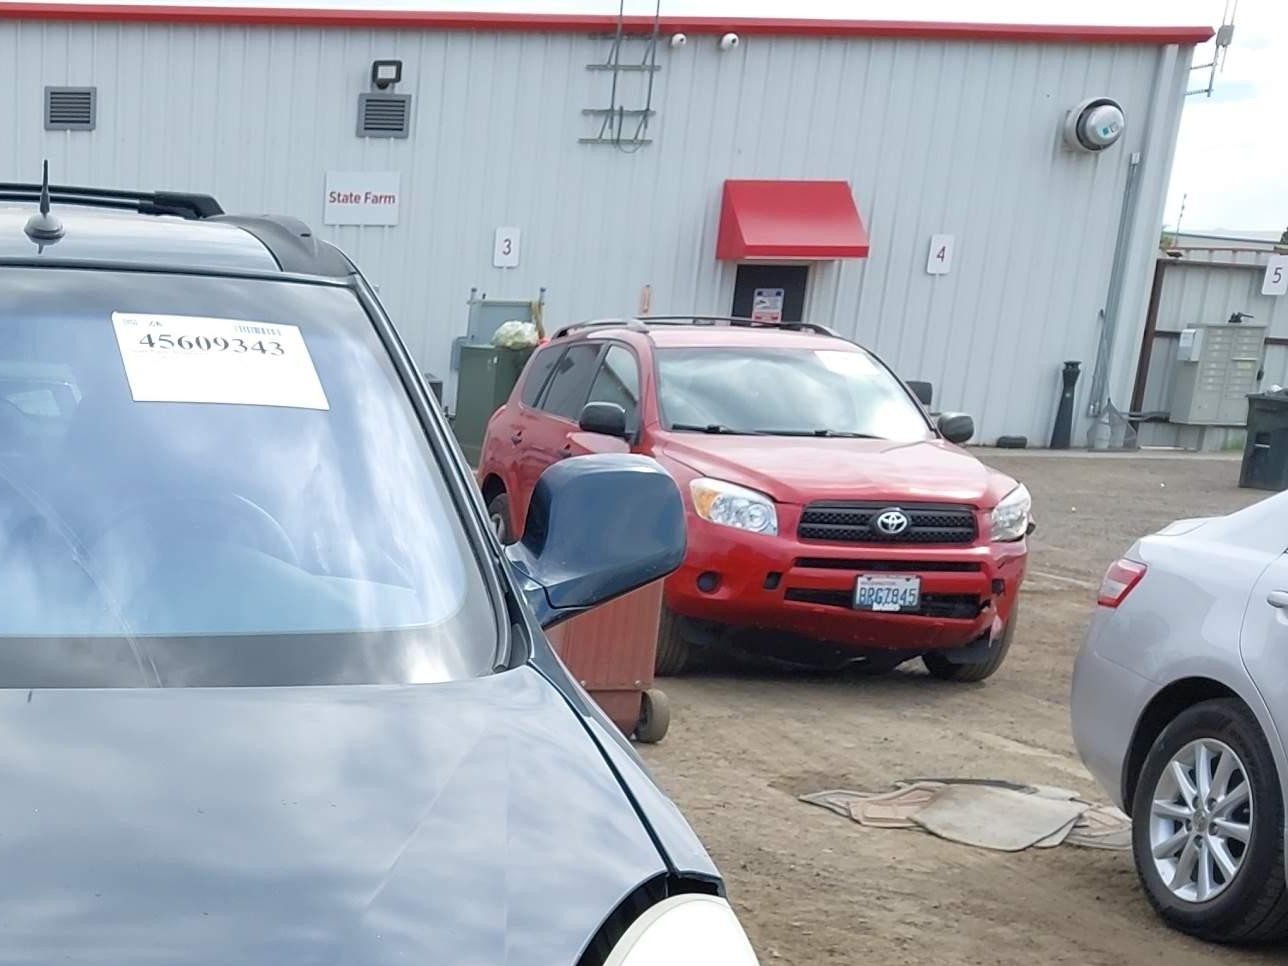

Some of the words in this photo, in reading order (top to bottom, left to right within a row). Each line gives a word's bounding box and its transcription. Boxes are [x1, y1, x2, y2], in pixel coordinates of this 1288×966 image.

[328, 191, 361, 204] State
[364, 191, 396, 204] Farm
[502, 238, 512, 256] 3
[936, 245, 946, 262] 4
[1272, 266, 1283, 284] 5
[139, 333, 285, 356] 45609343
